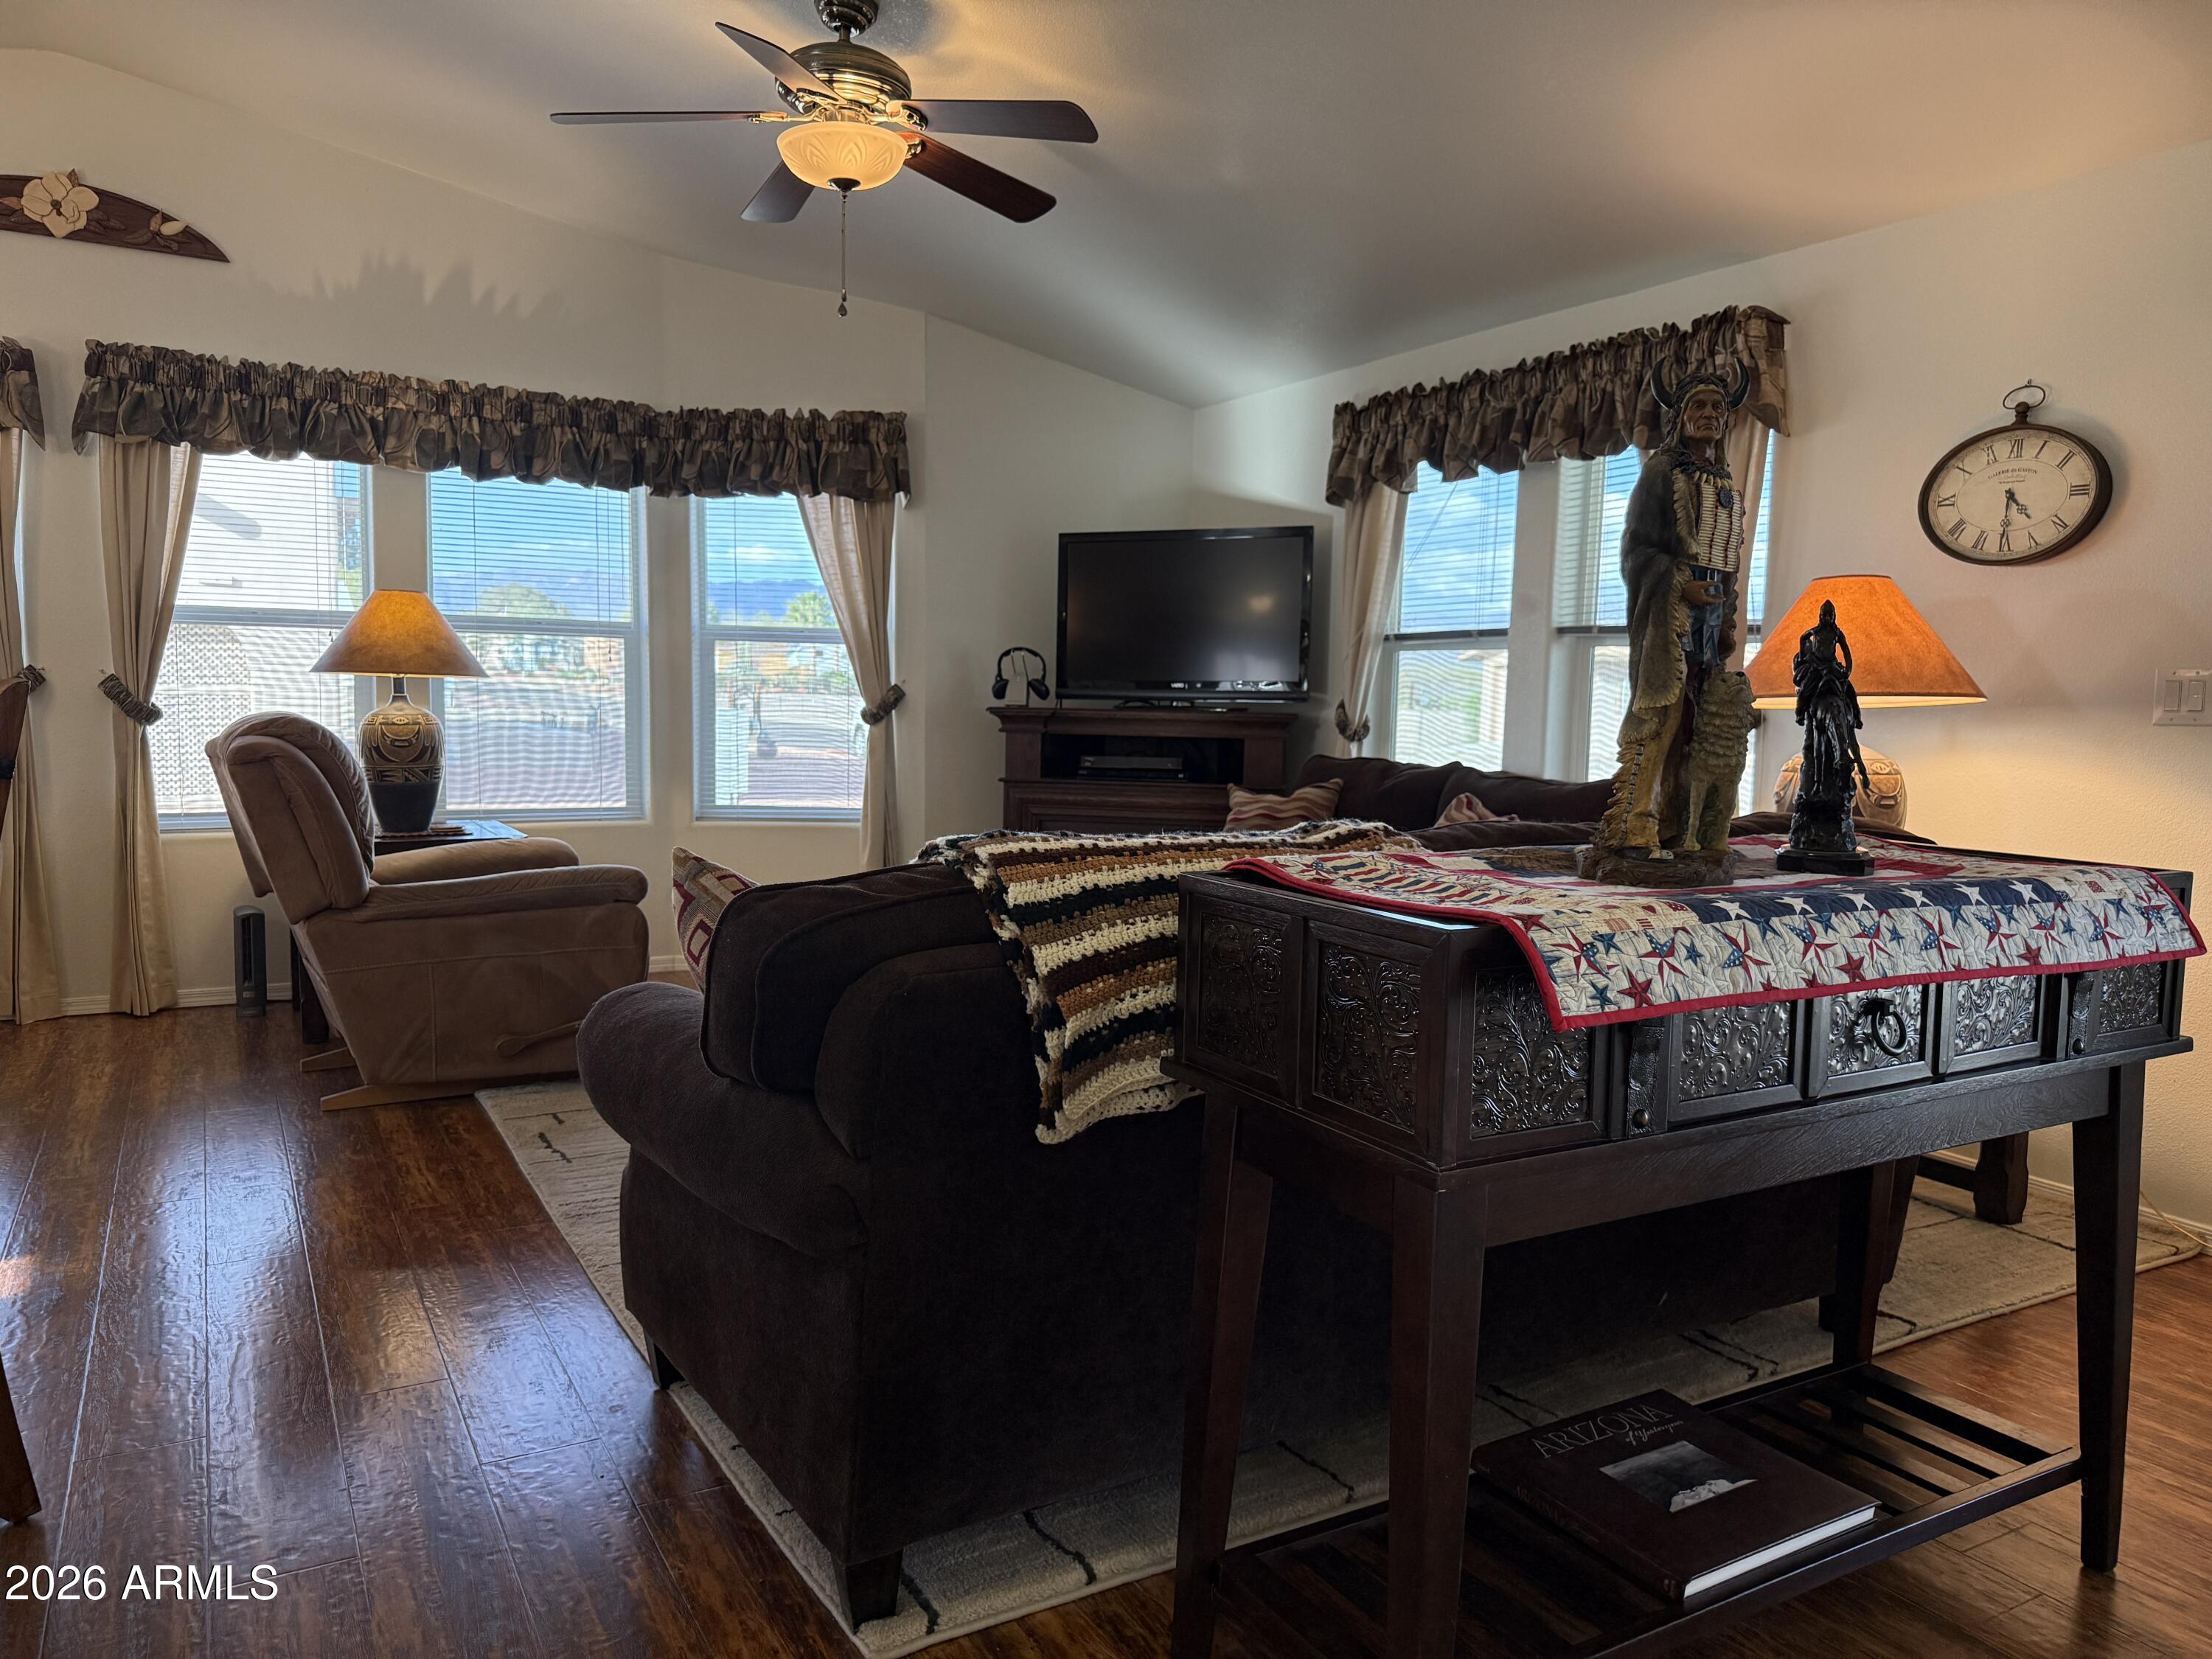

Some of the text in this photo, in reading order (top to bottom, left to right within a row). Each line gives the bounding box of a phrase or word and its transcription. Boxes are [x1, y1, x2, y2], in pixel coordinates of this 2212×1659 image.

[1981, 444, 2000, 465] XI
[2006, 438, 2025, 459] XII
[2034, 440, 2050, 459] I
[1954, 457, 1974, 480] X
[2056, 449, 2077, 471] II
[2069, 481, 2091, 499] III
[1937, 493, 1956, 509] IX
[1947, 518, 1967, 542] VIII
[1971, 530, 1989, 551] VII
[2027, 530, 2041, 549] V
[1531, 1404, 1673, 1458] ARIZONA
[1625, 1430, 1637, 1446] of
